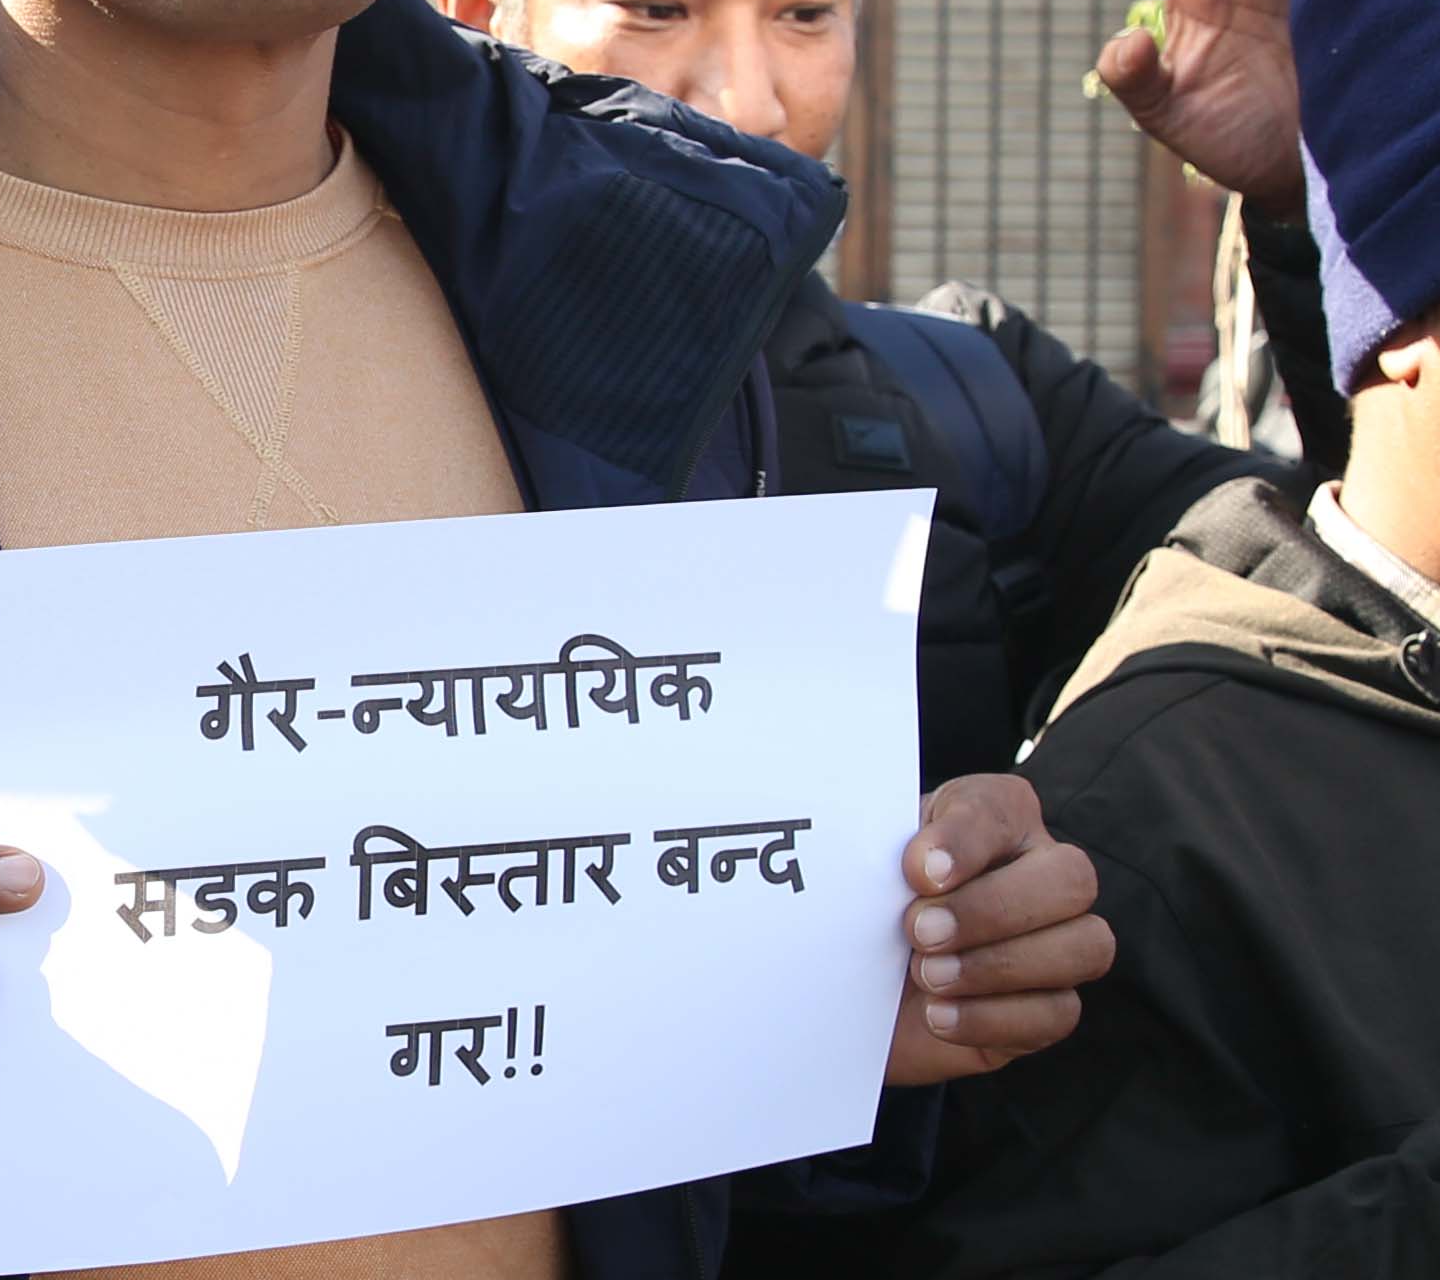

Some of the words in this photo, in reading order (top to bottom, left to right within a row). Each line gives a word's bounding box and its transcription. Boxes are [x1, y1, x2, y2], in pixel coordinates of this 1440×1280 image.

[113, 855, 327, 945] सडक
[348, 824, 632, 922] बिस्तार
[652, 817, 813, 895] बन्द
[384, 1003, 546, 1088] गर!!
